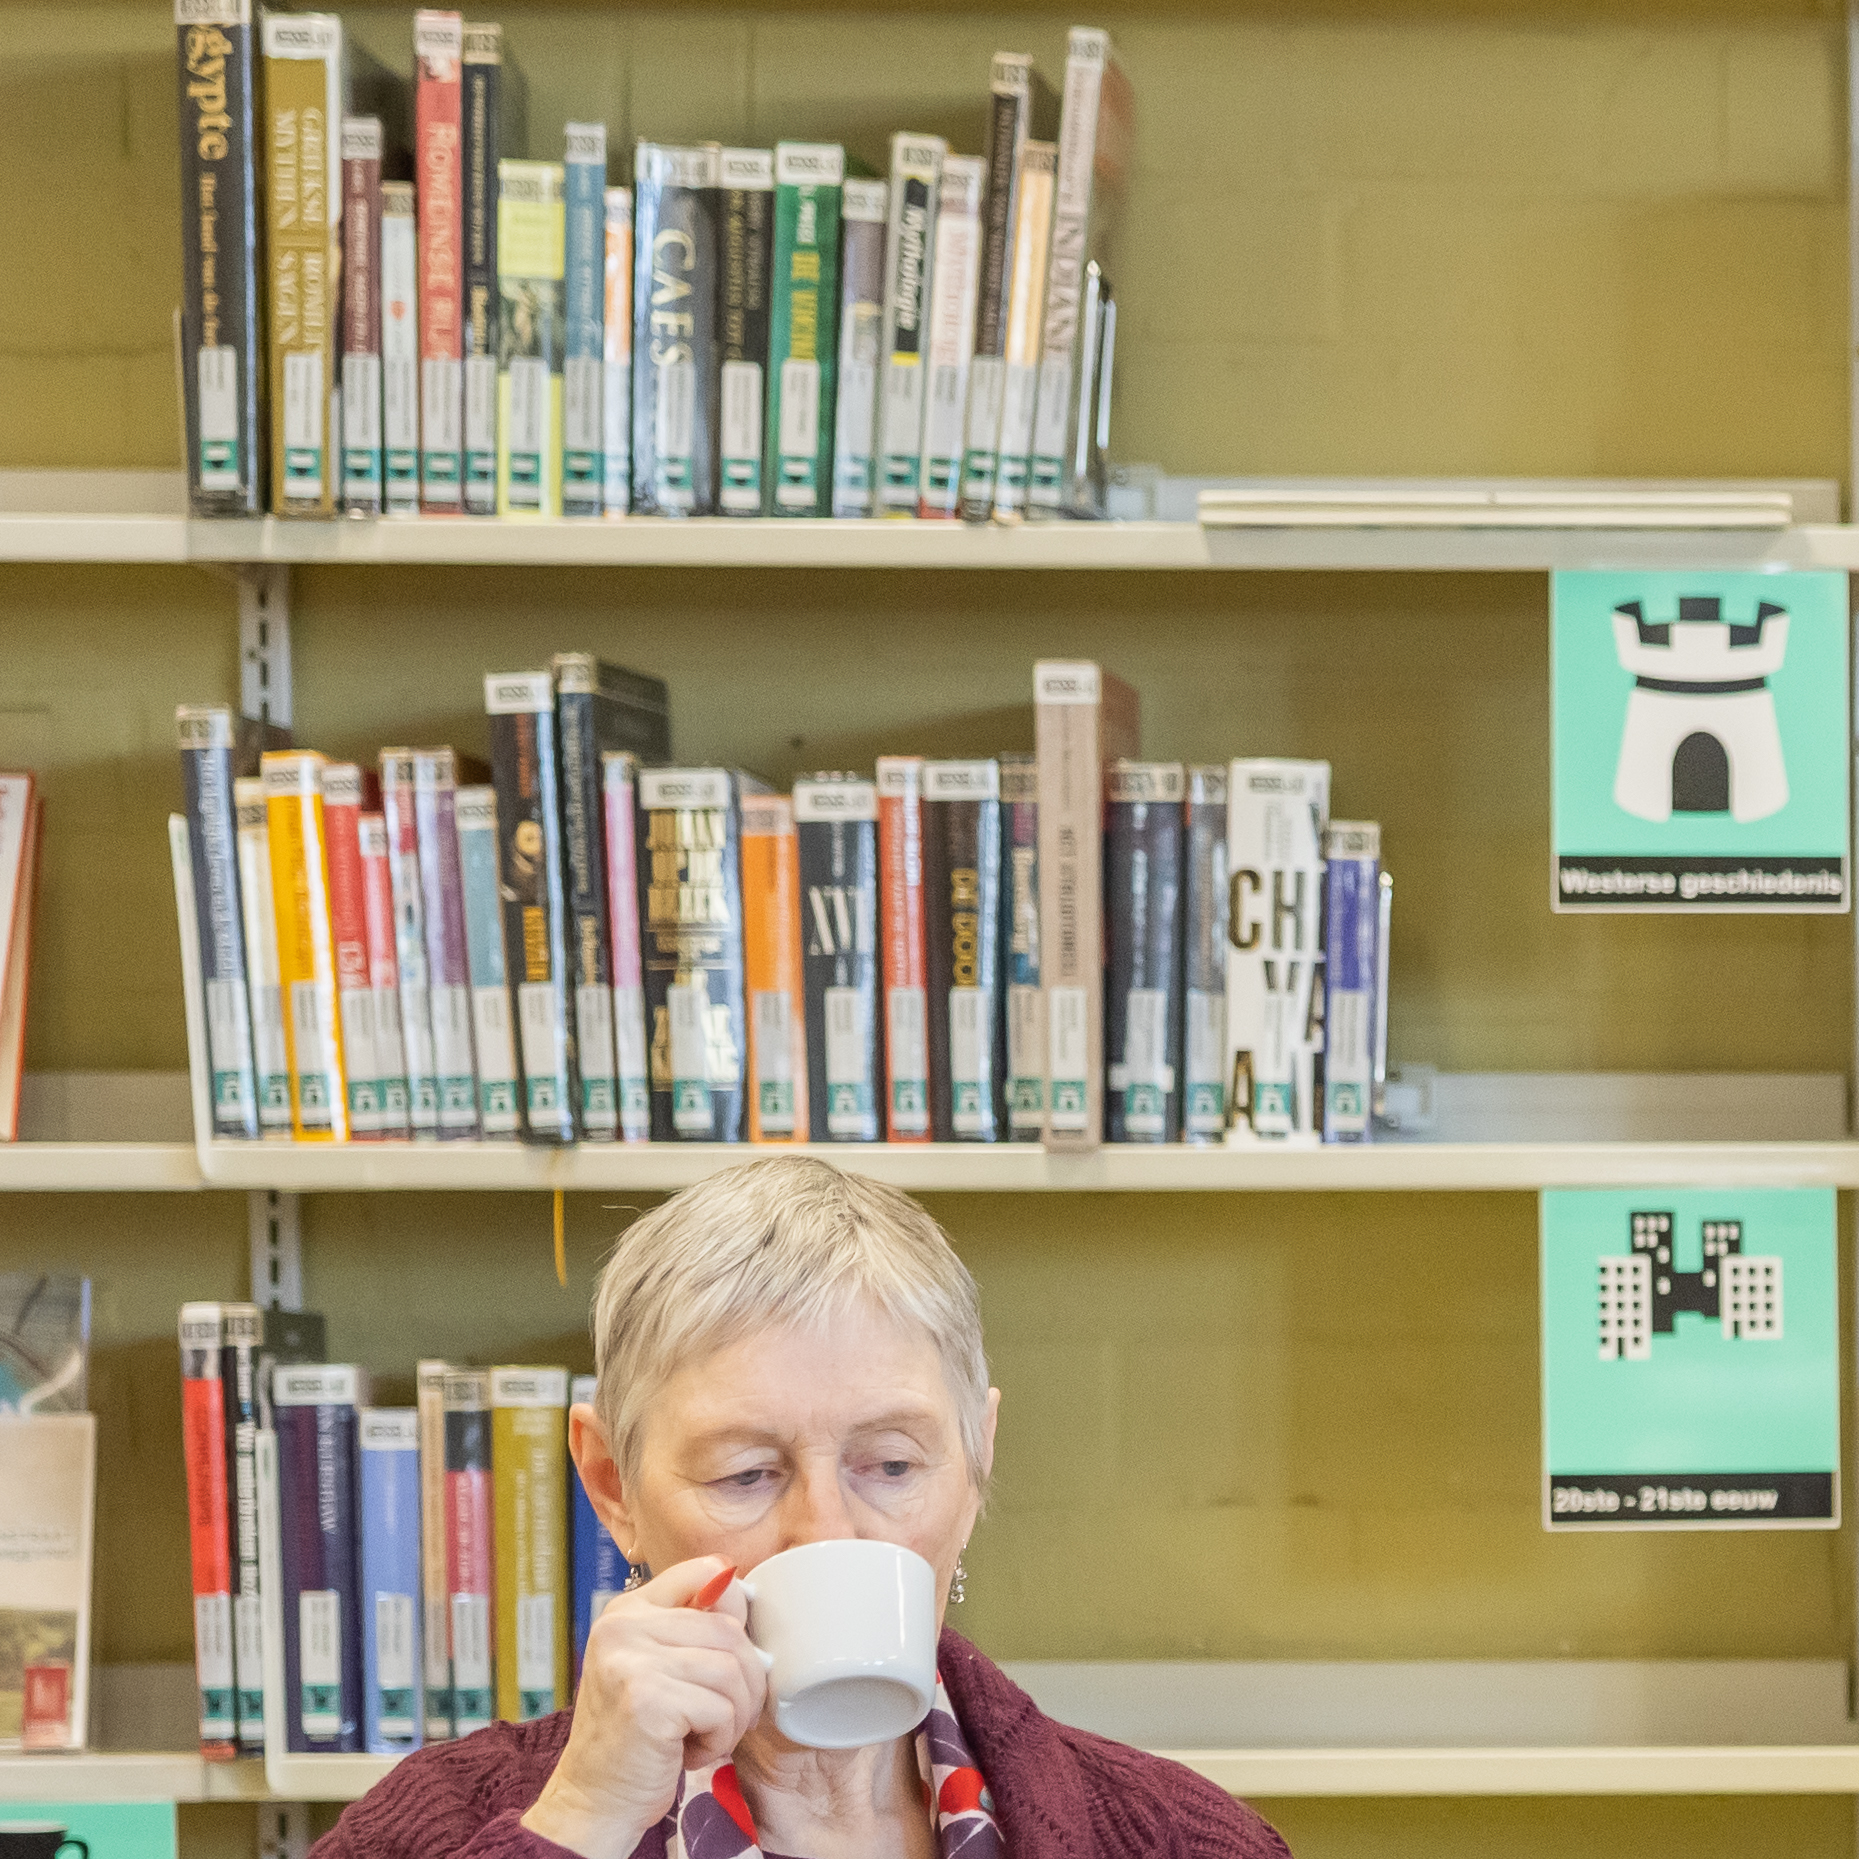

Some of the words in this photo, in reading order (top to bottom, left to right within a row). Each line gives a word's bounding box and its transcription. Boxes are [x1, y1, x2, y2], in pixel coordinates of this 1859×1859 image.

[187, 27, 234, 161] gypte
[1560, 868, 1677, 894] Westerse
[1679, 868, 1843, 899] geschiedenis
[1552, 1486, 1621, 1513] 20ste
[1639, 1486, 1708, 1512] 21ste
[1709, 1488, 1779, 1512] eeuw
